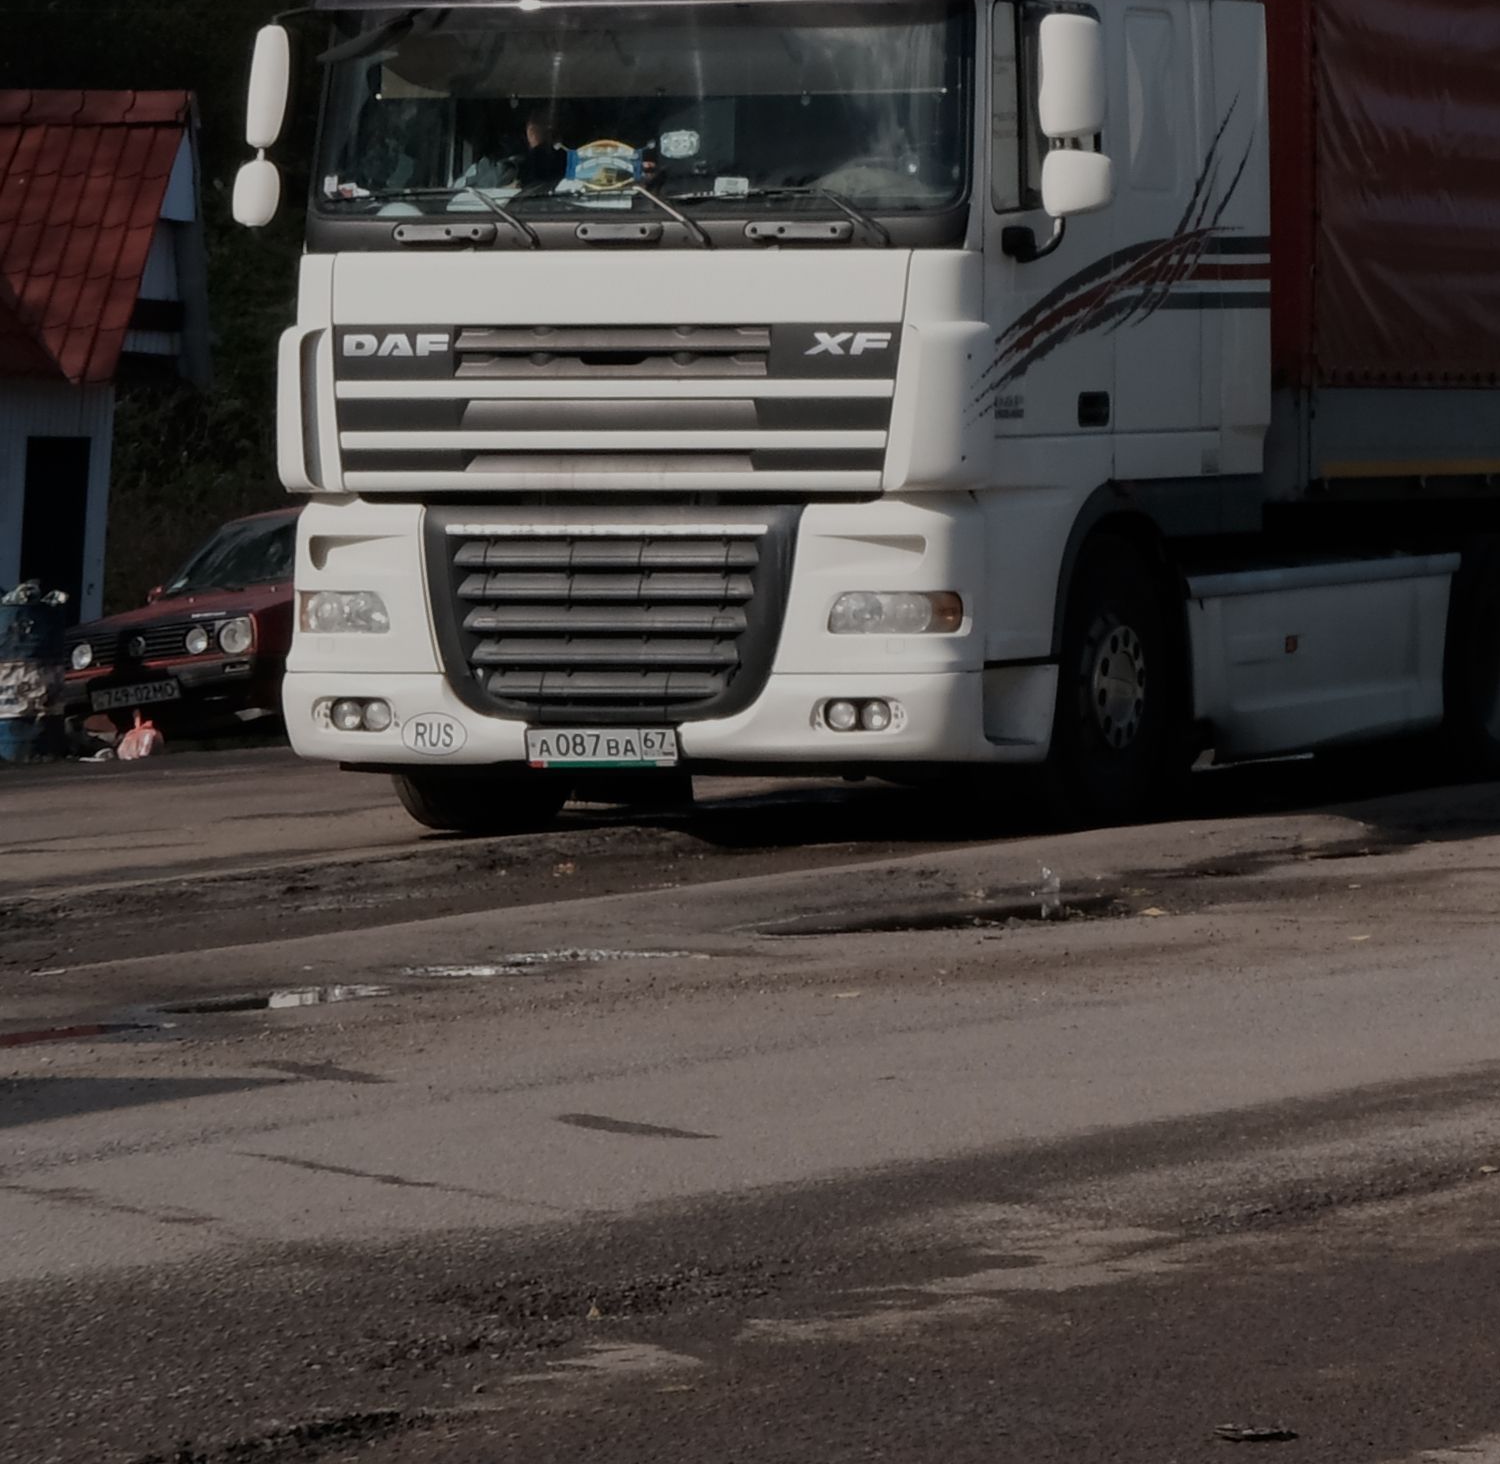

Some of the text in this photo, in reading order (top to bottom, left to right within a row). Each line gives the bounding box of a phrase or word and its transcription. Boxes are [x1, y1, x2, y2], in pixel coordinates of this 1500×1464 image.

[343, 333, 449, 357] DAF
[803, 332, 892, 356] XF
[413, 722, 455, 748] RUS
[643, 731, 667, 749] 67
